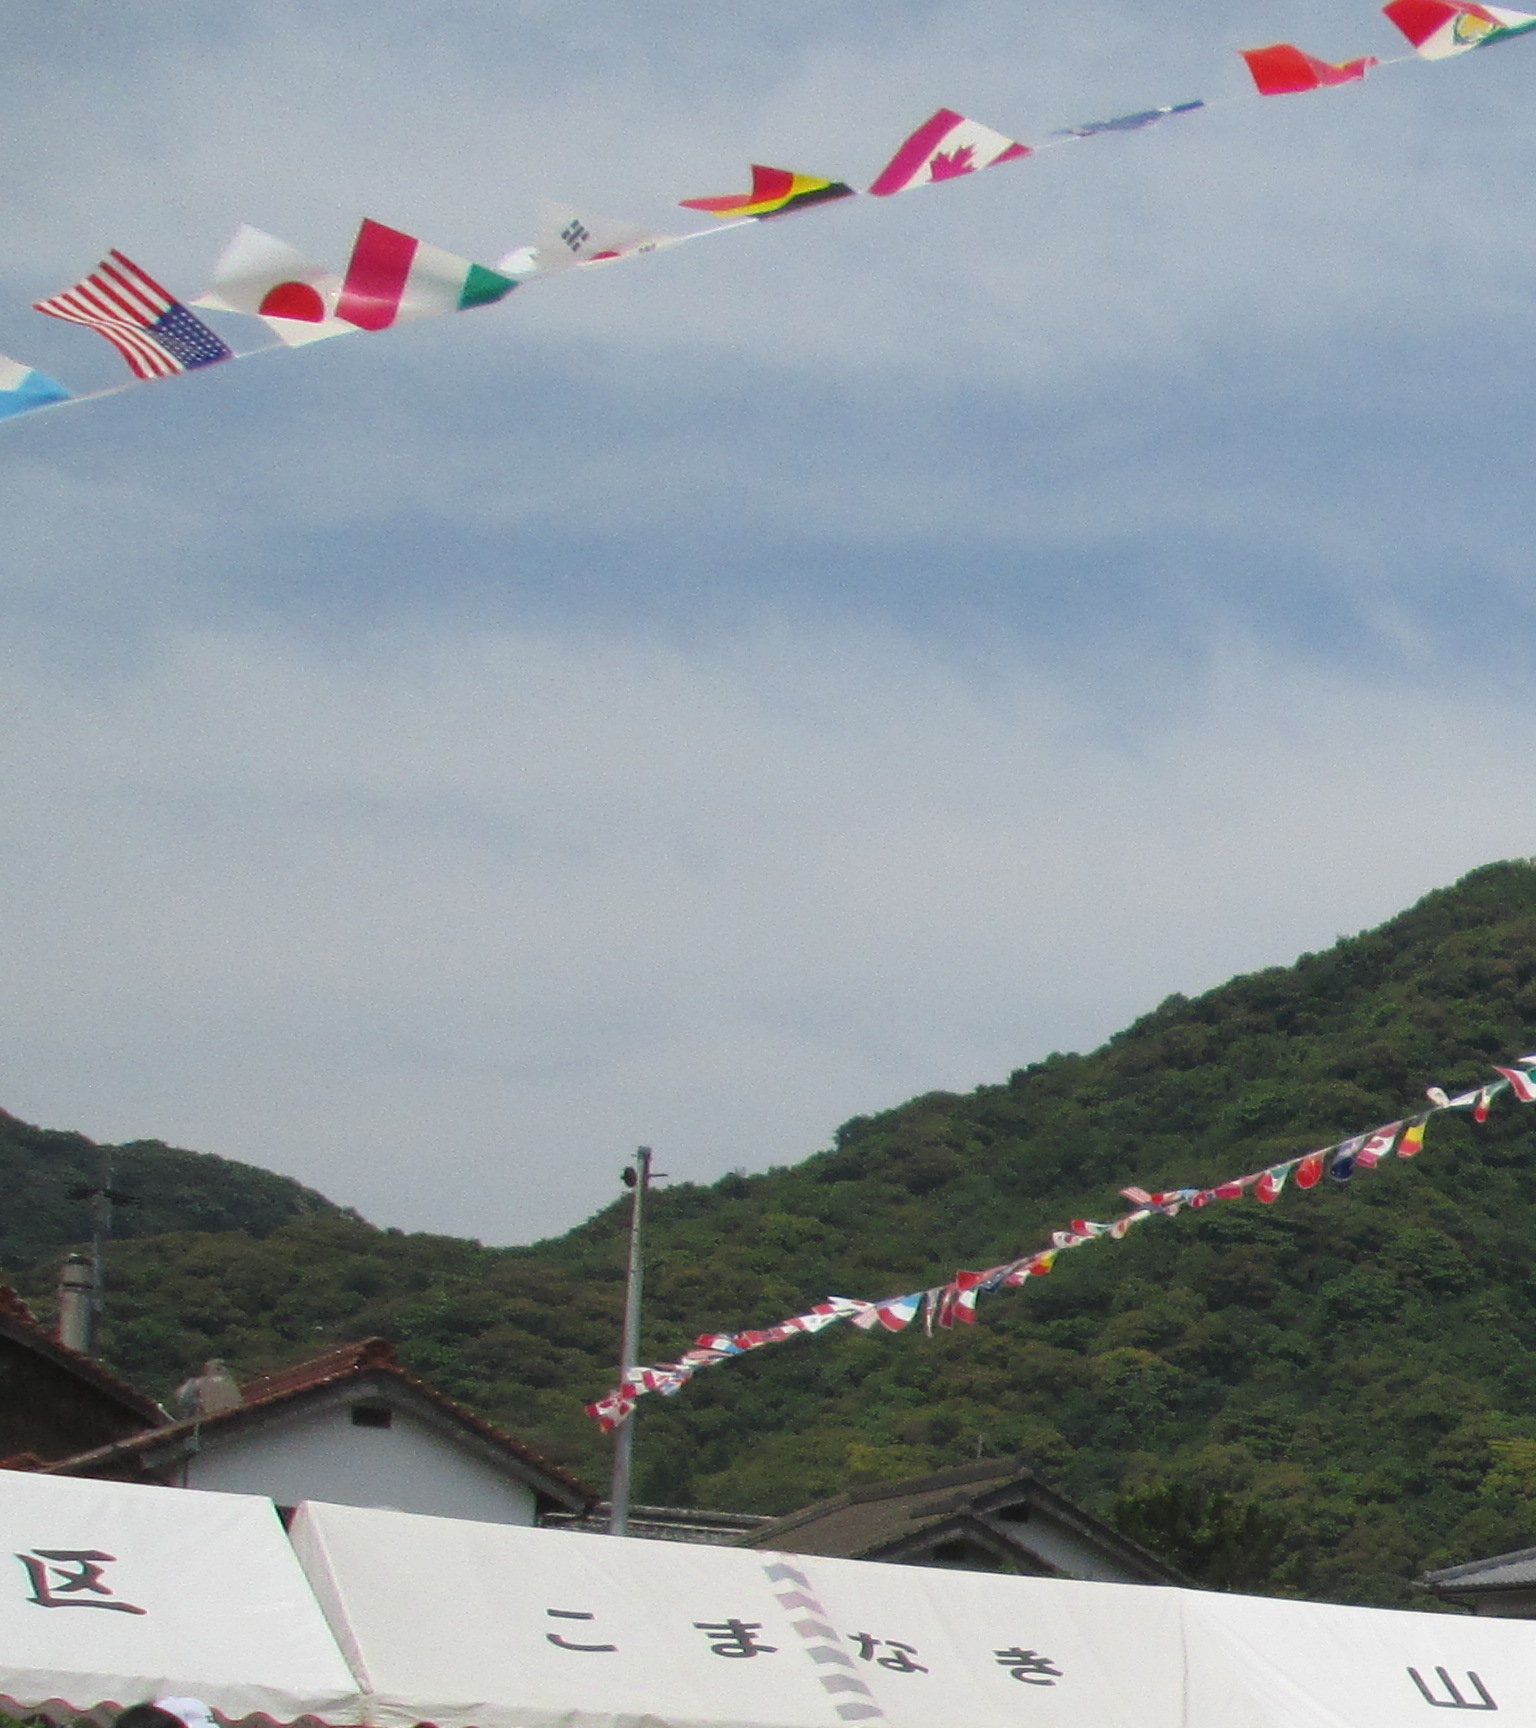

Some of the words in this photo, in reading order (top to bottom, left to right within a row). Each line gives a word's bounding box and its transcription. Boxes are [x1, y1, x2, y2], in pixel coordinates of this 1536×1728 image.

[14, 1548, 147, 1616] 区
[546, 1608, 1064, 1687] こまなき
